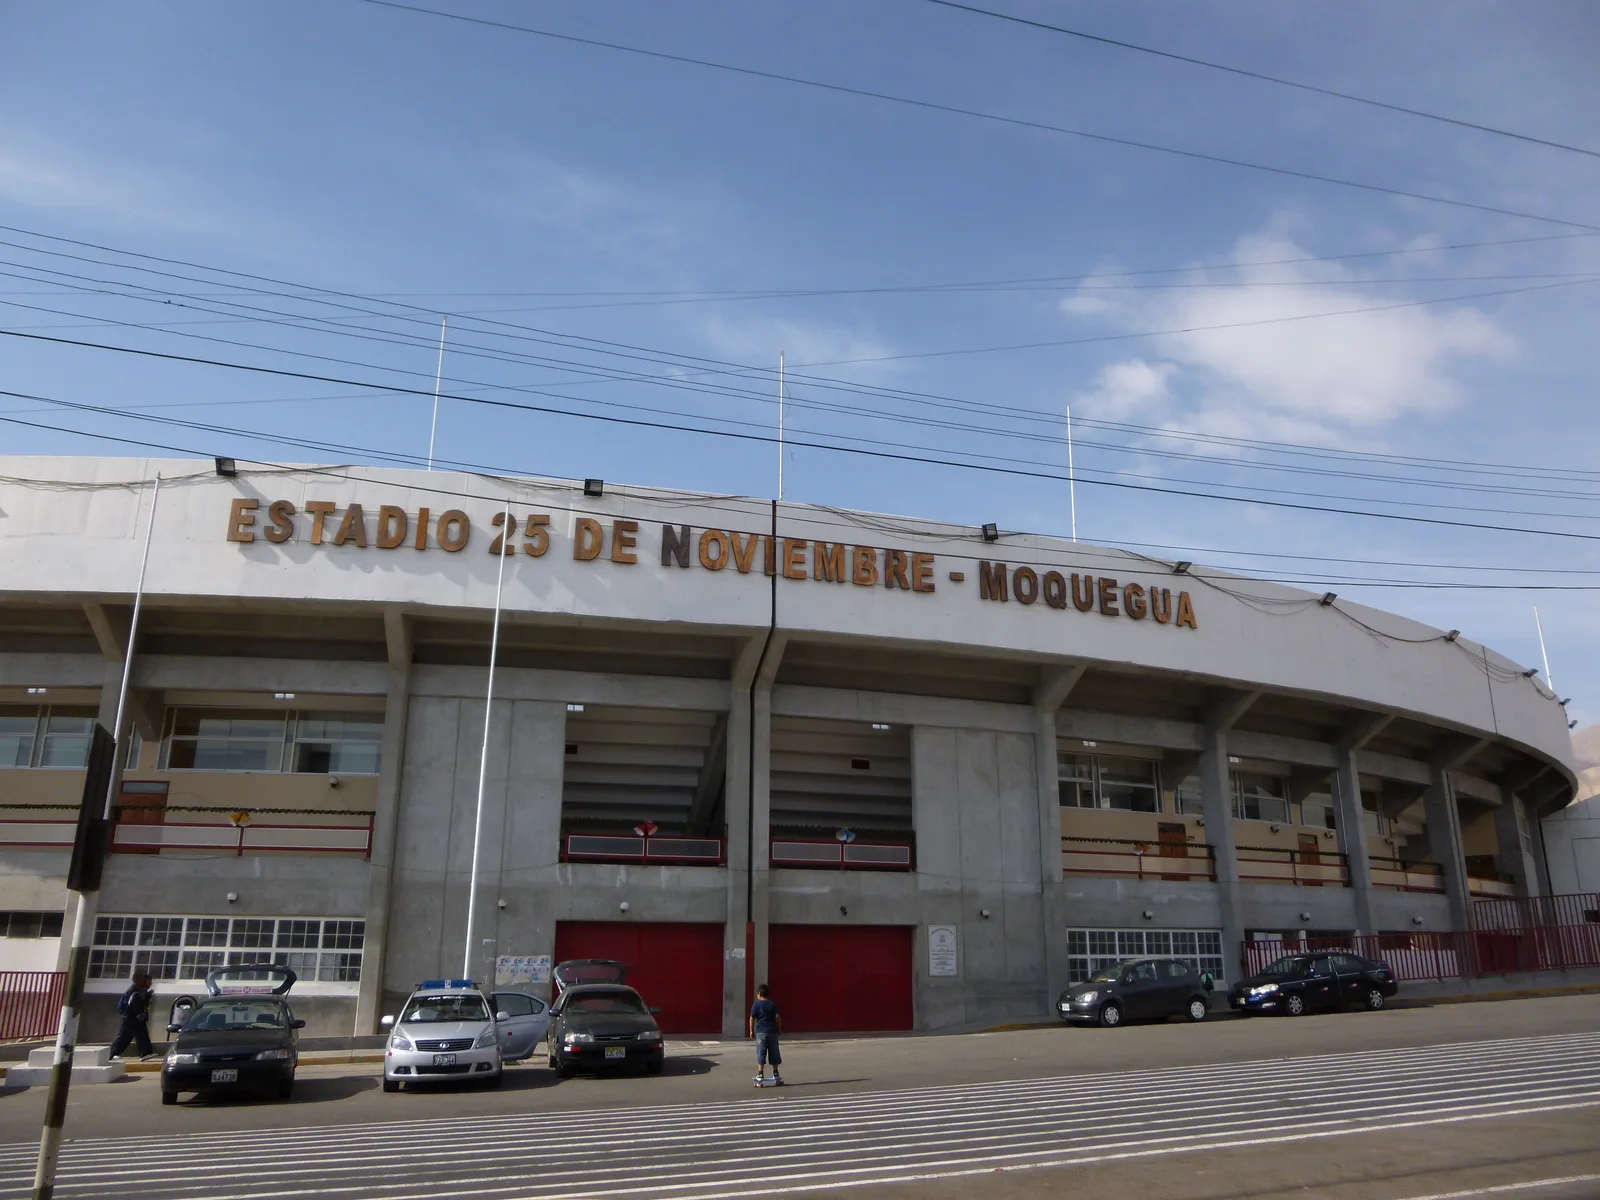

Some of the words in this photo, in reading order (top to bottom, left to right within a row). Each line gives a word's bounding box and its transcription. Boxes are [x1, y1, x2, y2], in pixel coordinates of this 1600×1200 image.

[226, 498, 470, 552] ESTADIO
[488, 511, 551, 558] 25
[573, 517, 639, 565] DE
[661, 524, 936, 593] NOVIEMBRE
[949, 571, 965, 582] -
[979, 560, 1198, 630] MOQUEGUA
